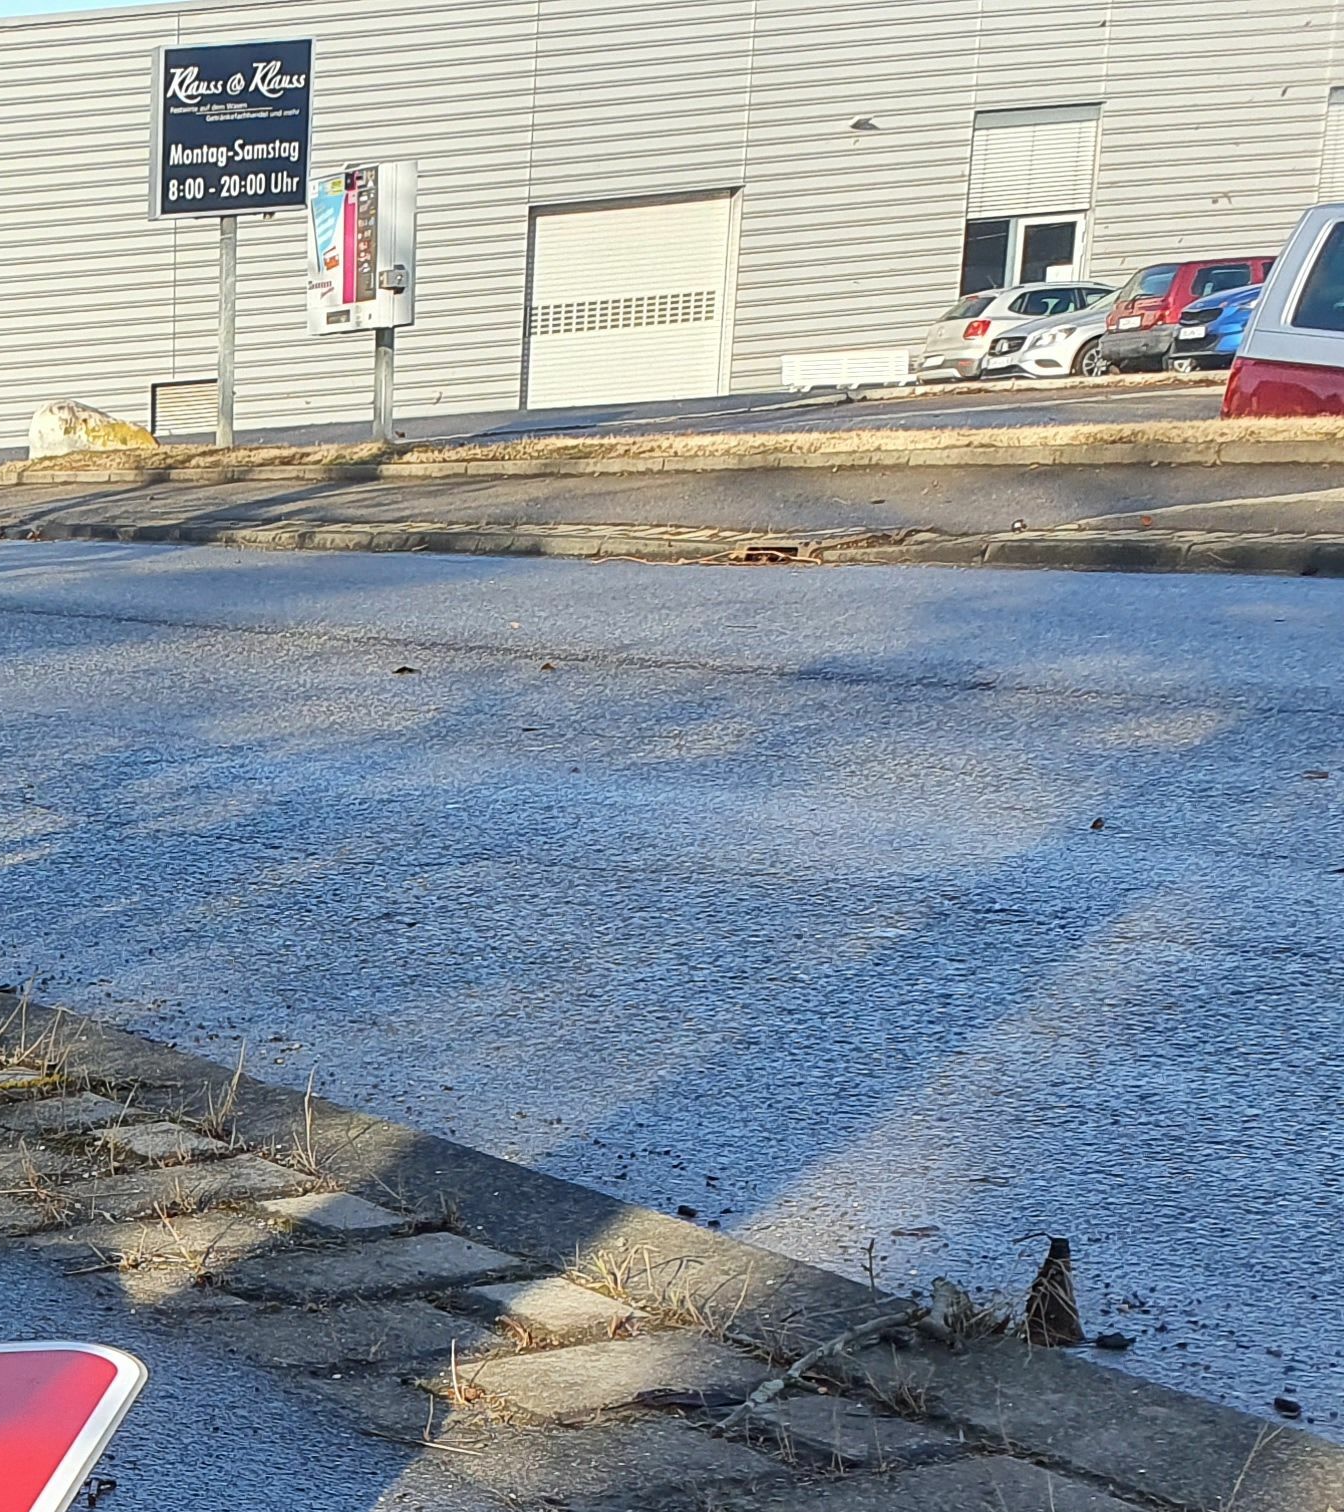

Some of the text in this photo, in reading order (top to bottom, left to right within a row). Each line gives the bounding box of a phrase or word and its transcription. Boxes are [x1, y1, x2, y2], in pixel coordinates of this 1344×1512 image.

[166, 66, 223, 104] Klauss
[249, 60, 306, 98] Klauss
[270, 109, 282, 117] und
[169, 139, 300, 167] Montag-Samstag
[168, 178, 204, 201] 8:00
[220, 173, 266, 198] 20:00
[271, 171, 300, 193] Uhr
